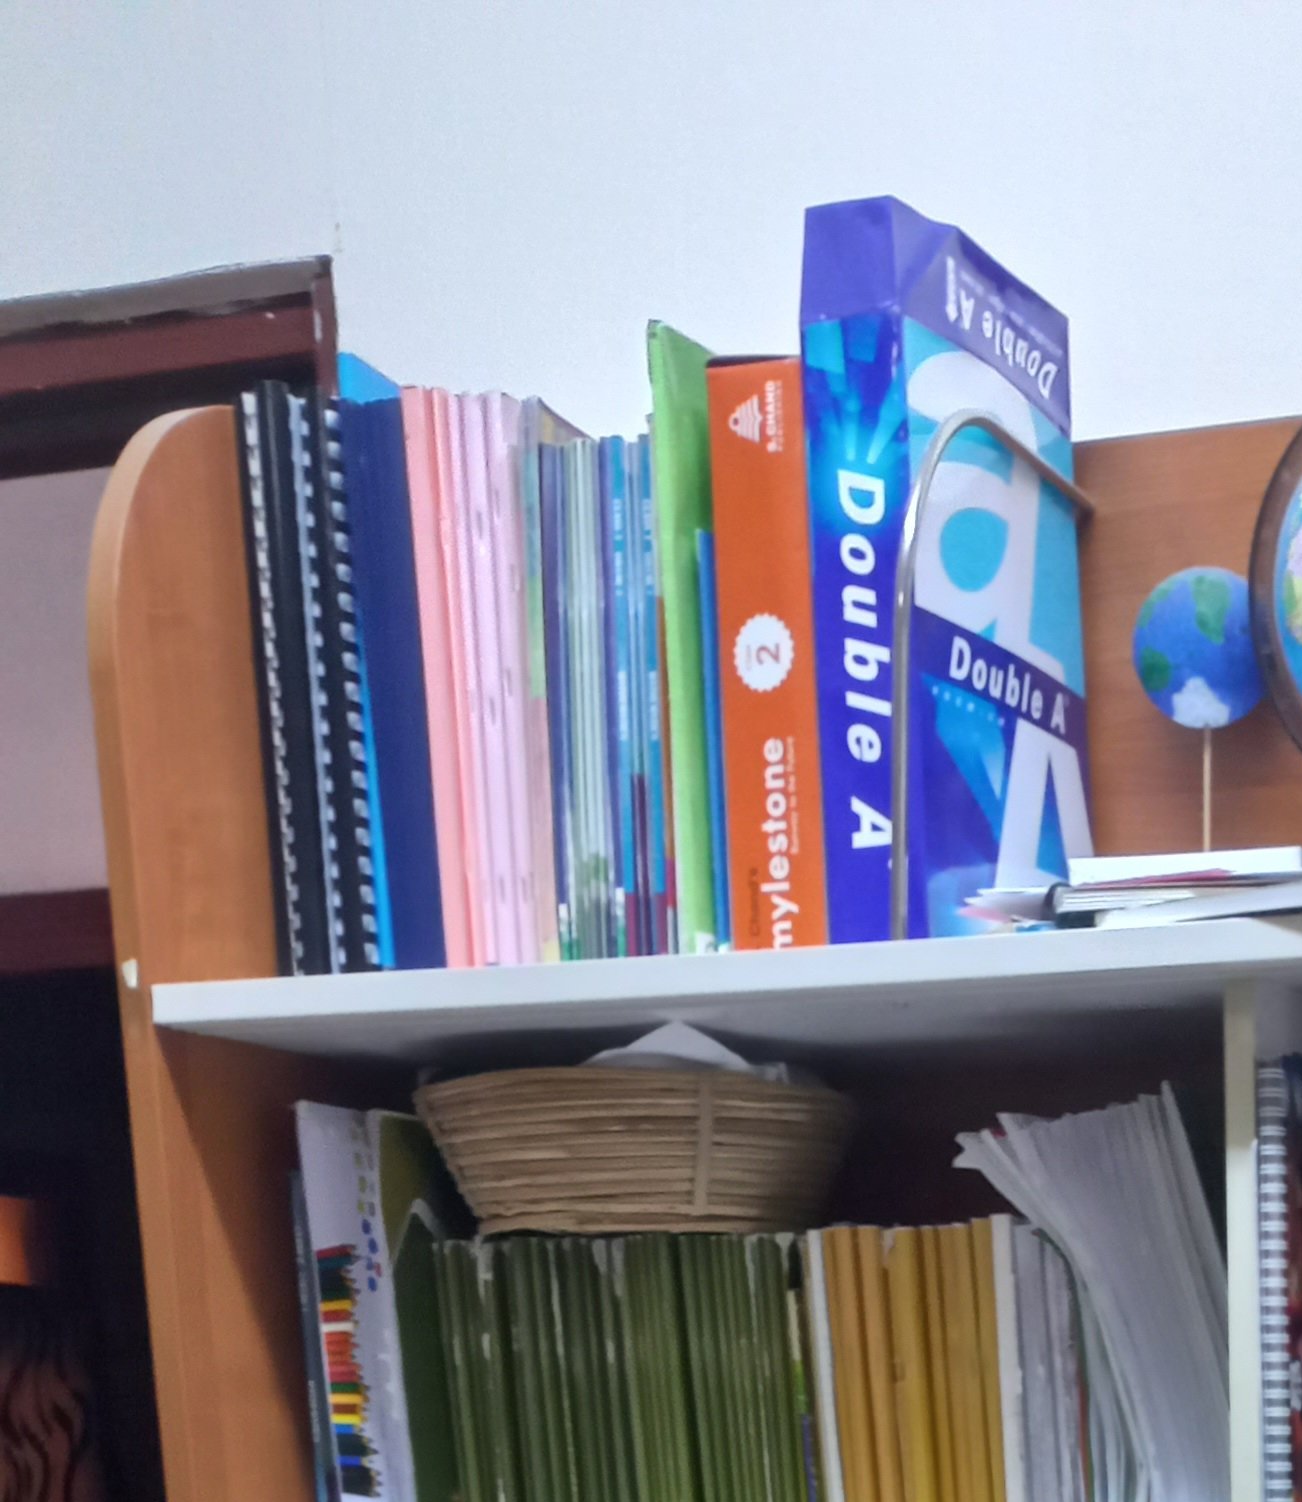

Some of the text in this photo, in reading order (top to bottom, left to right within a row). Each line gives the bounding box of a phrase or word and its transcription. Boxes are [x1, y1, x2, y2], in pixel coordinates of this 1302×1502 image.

[960, 288, 976, 331] A
[982, 309, 1060, 400] Double
[765, 380, 776, 436] CHAND
[757, 643, 780, 665] 2
[838, 469, 893, 849] Double A
[949, 636, 1044, 720] Double
[1050, 694, 1066, 735] A
[760, 738, 800, 949] mylestone
